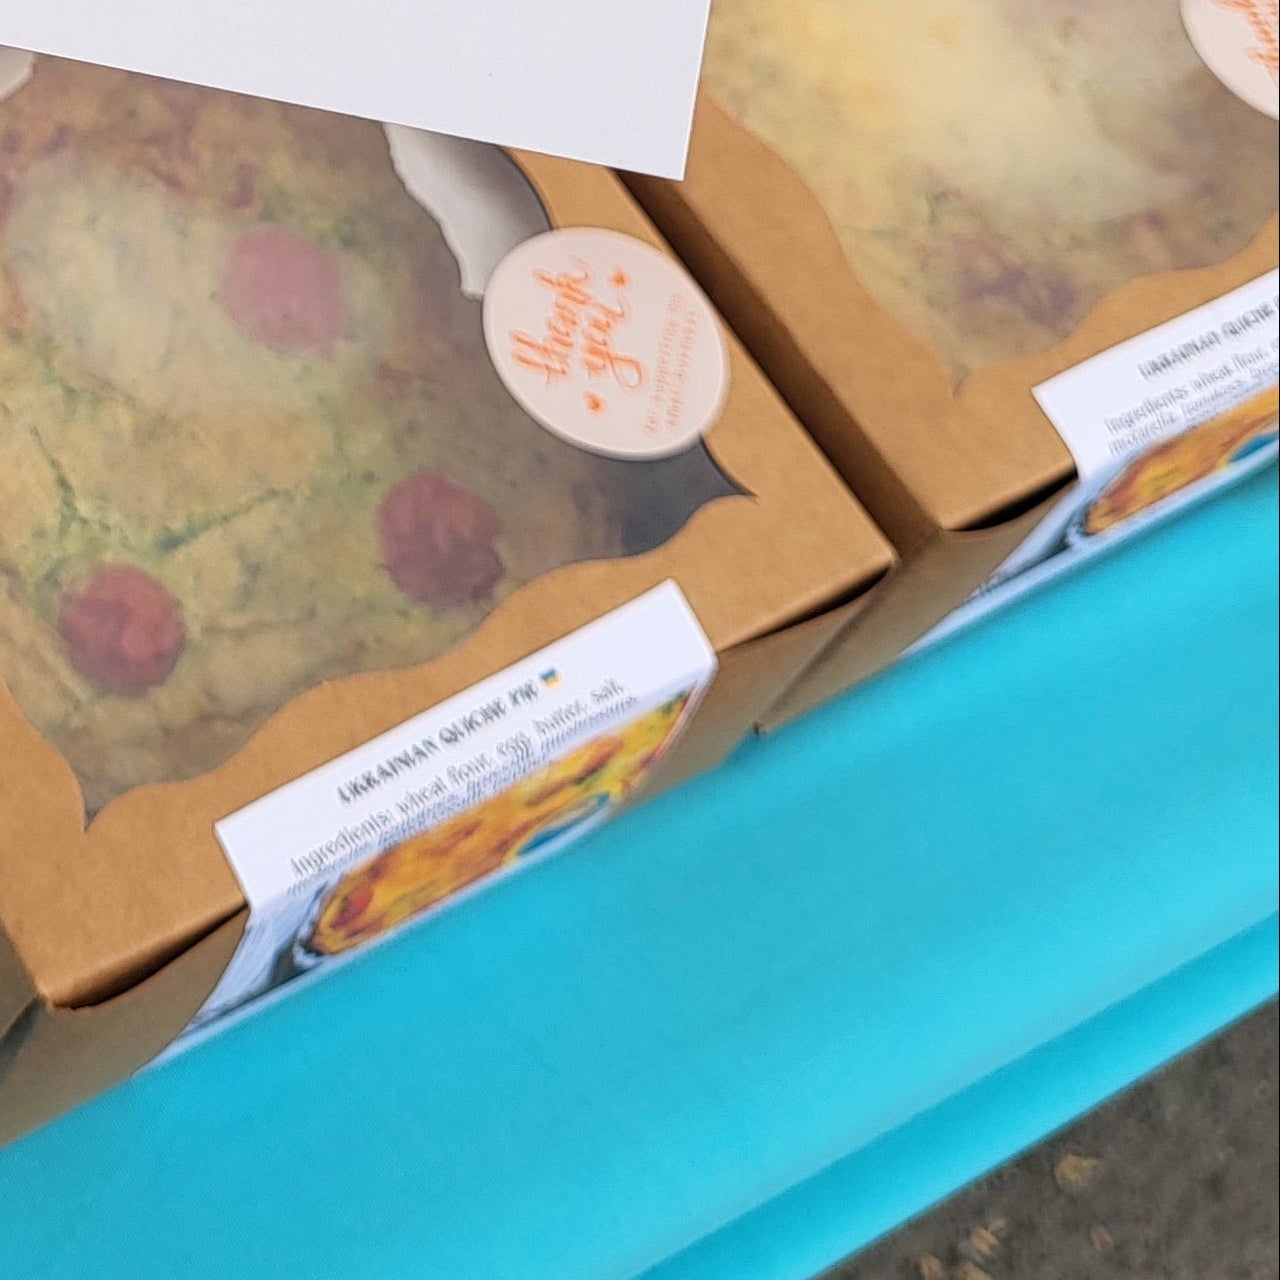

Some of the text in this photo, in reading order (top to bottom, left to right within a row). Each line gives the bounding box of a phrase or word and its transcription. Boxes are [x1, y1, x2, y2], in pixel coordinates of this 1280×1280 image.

[508, 256, 595, 386] thank
[338, 735, 442, 804] UKRAINIAN
[291, 806, 392, 876] Ingredients:
[397, 780, 449, 815] wheat
